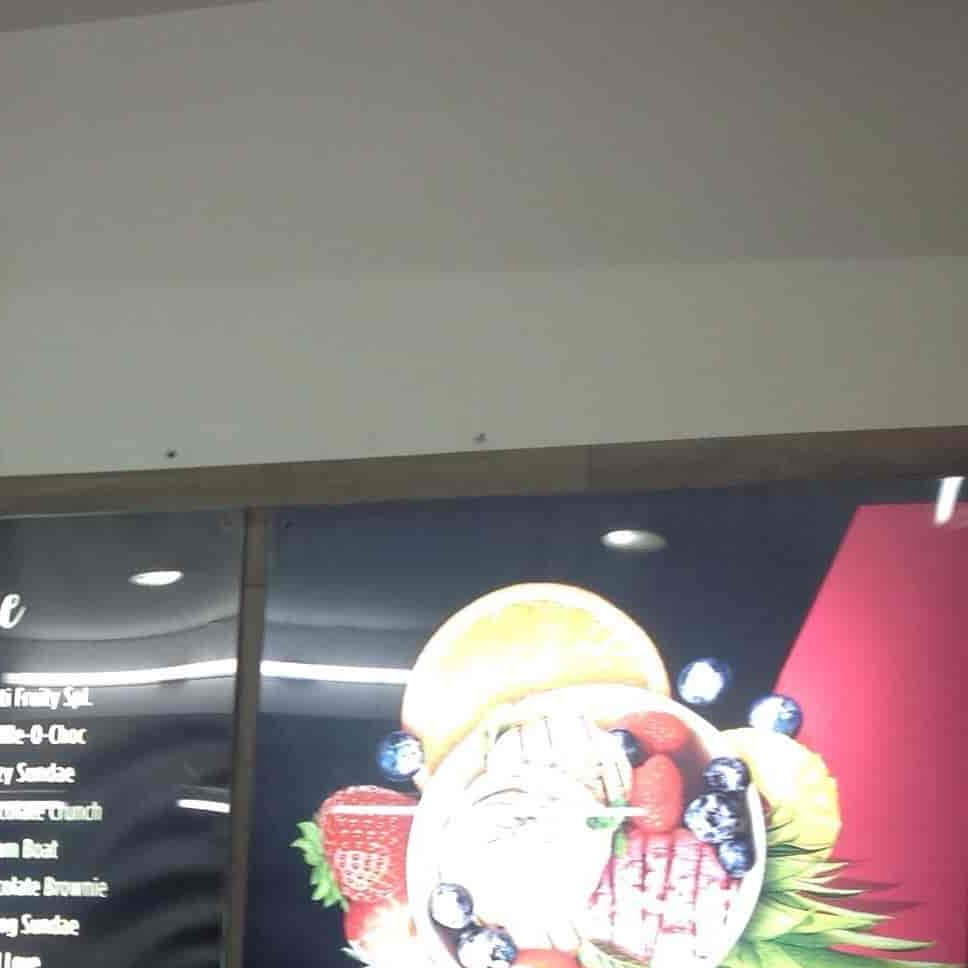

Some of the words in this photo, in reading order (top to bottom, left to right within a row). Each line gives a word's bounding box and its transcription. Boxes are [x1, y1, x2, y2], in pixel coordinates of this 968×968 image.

[15, 762, 77, 784] Sundae
[42, 875, 110, 898] Brownie
[19, 913, 81, 936] Sundae
